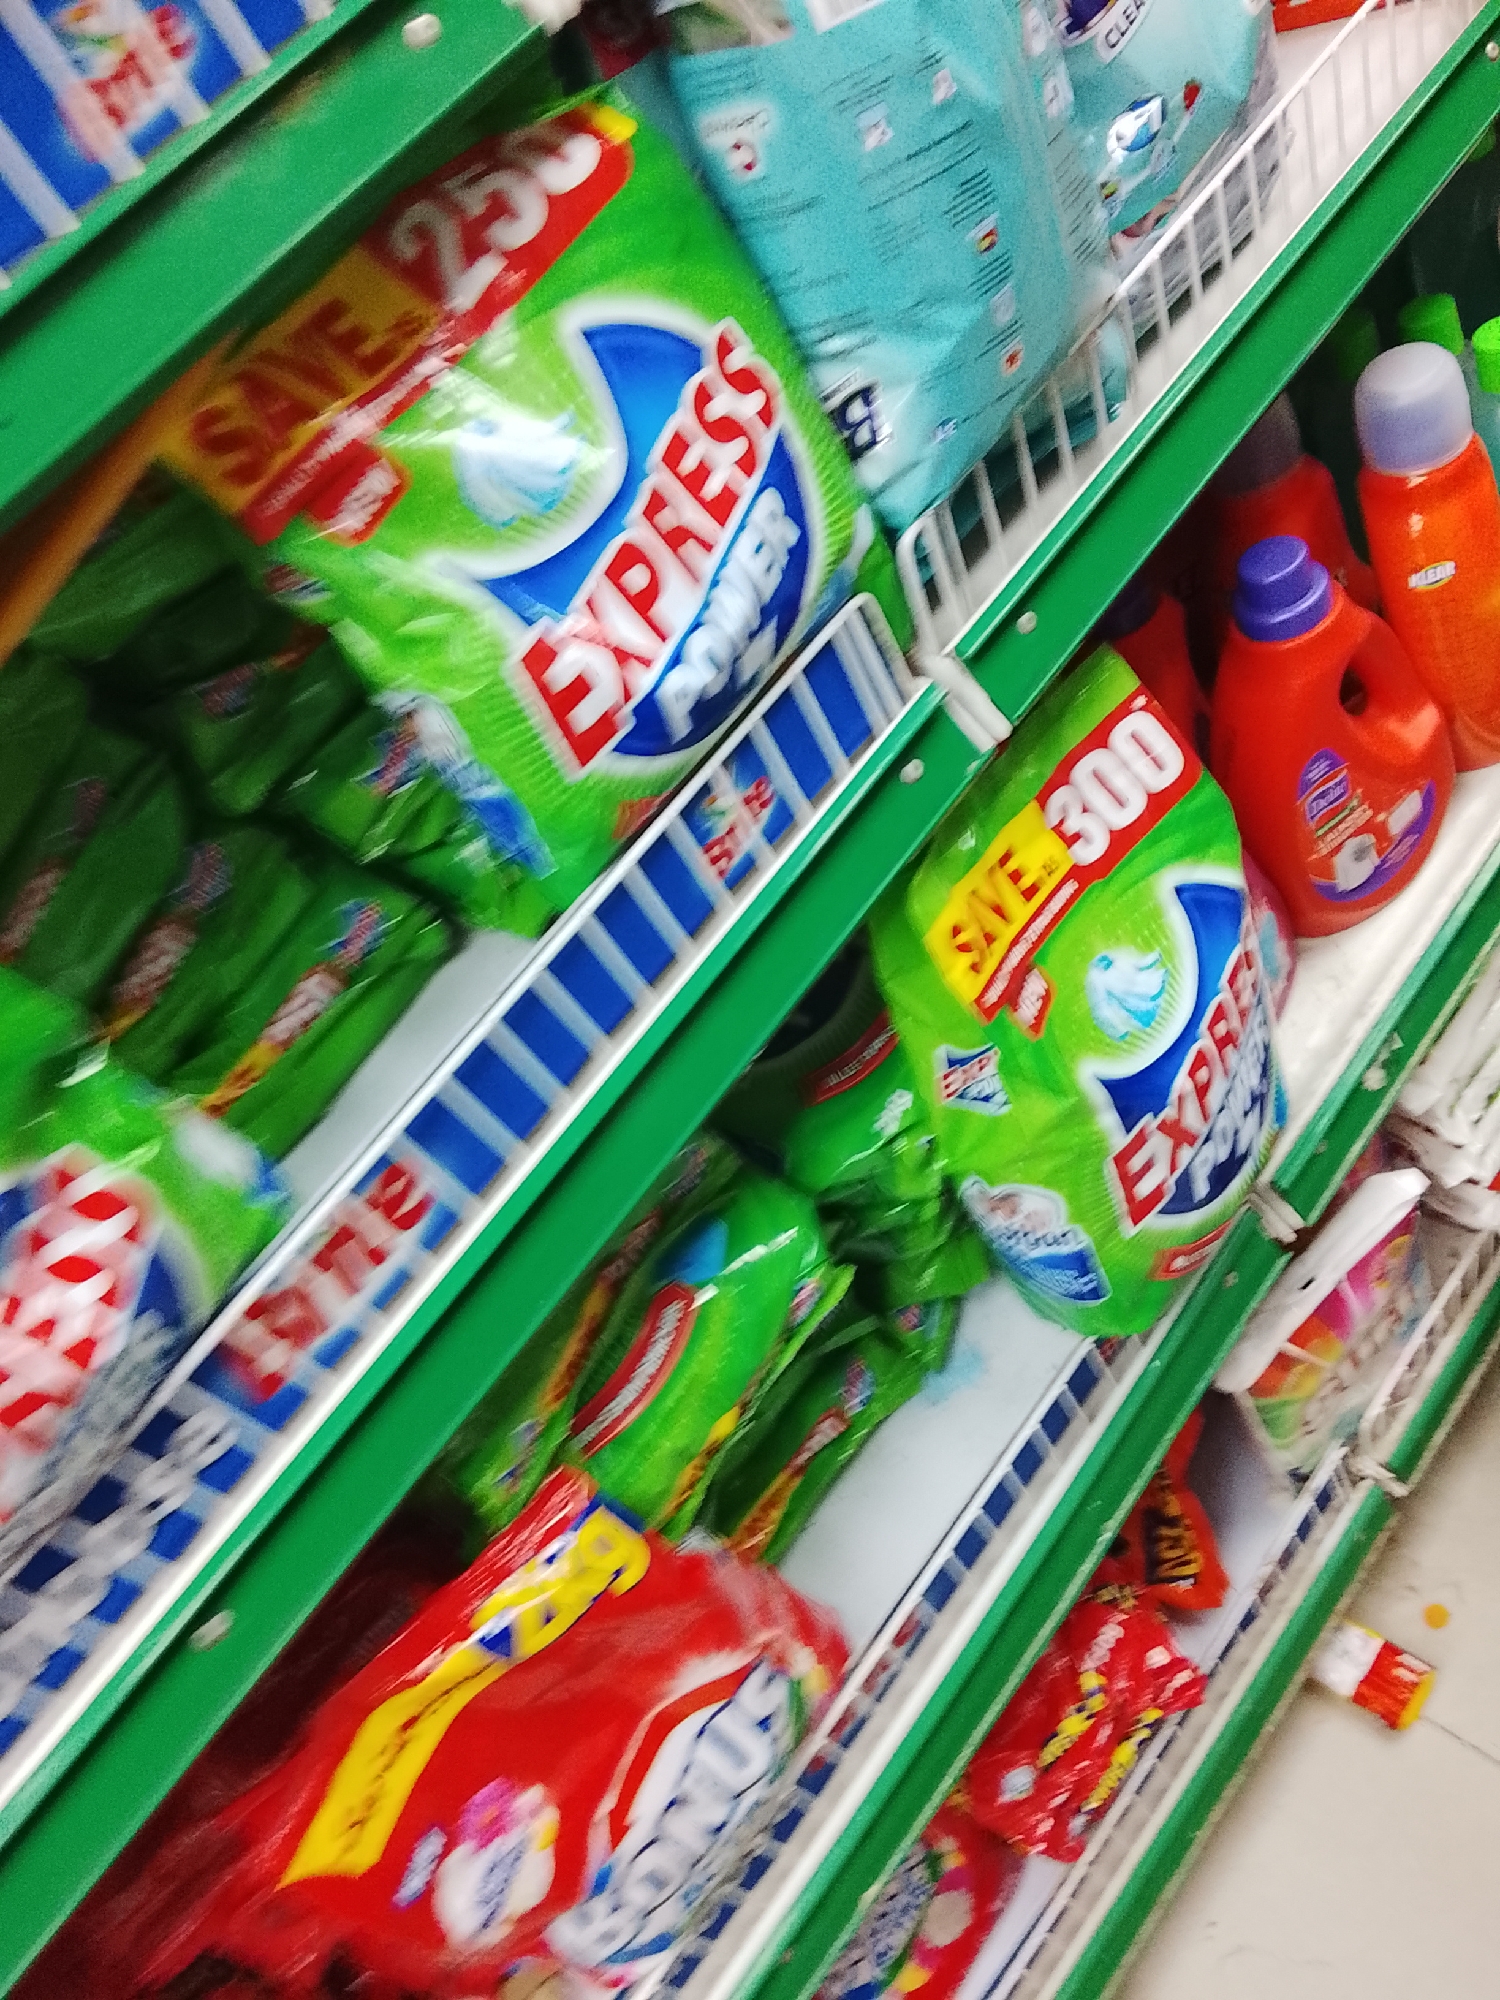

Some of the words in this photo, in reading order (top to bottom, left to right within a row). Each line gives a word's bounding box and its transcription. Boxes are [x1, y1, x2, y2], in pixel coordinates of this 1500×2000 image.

[188, 300, 398, 486] SAVE
[388, 126, 602, 314] 250
[520, 328, 774, 768] EXPRESS
[656, 485, 801, 744] POWER
[951, 846, 1040, 974] SAVE
[1044, 709, 1186, 867] 300
[547, 1655, 789, 1969] BONUS
